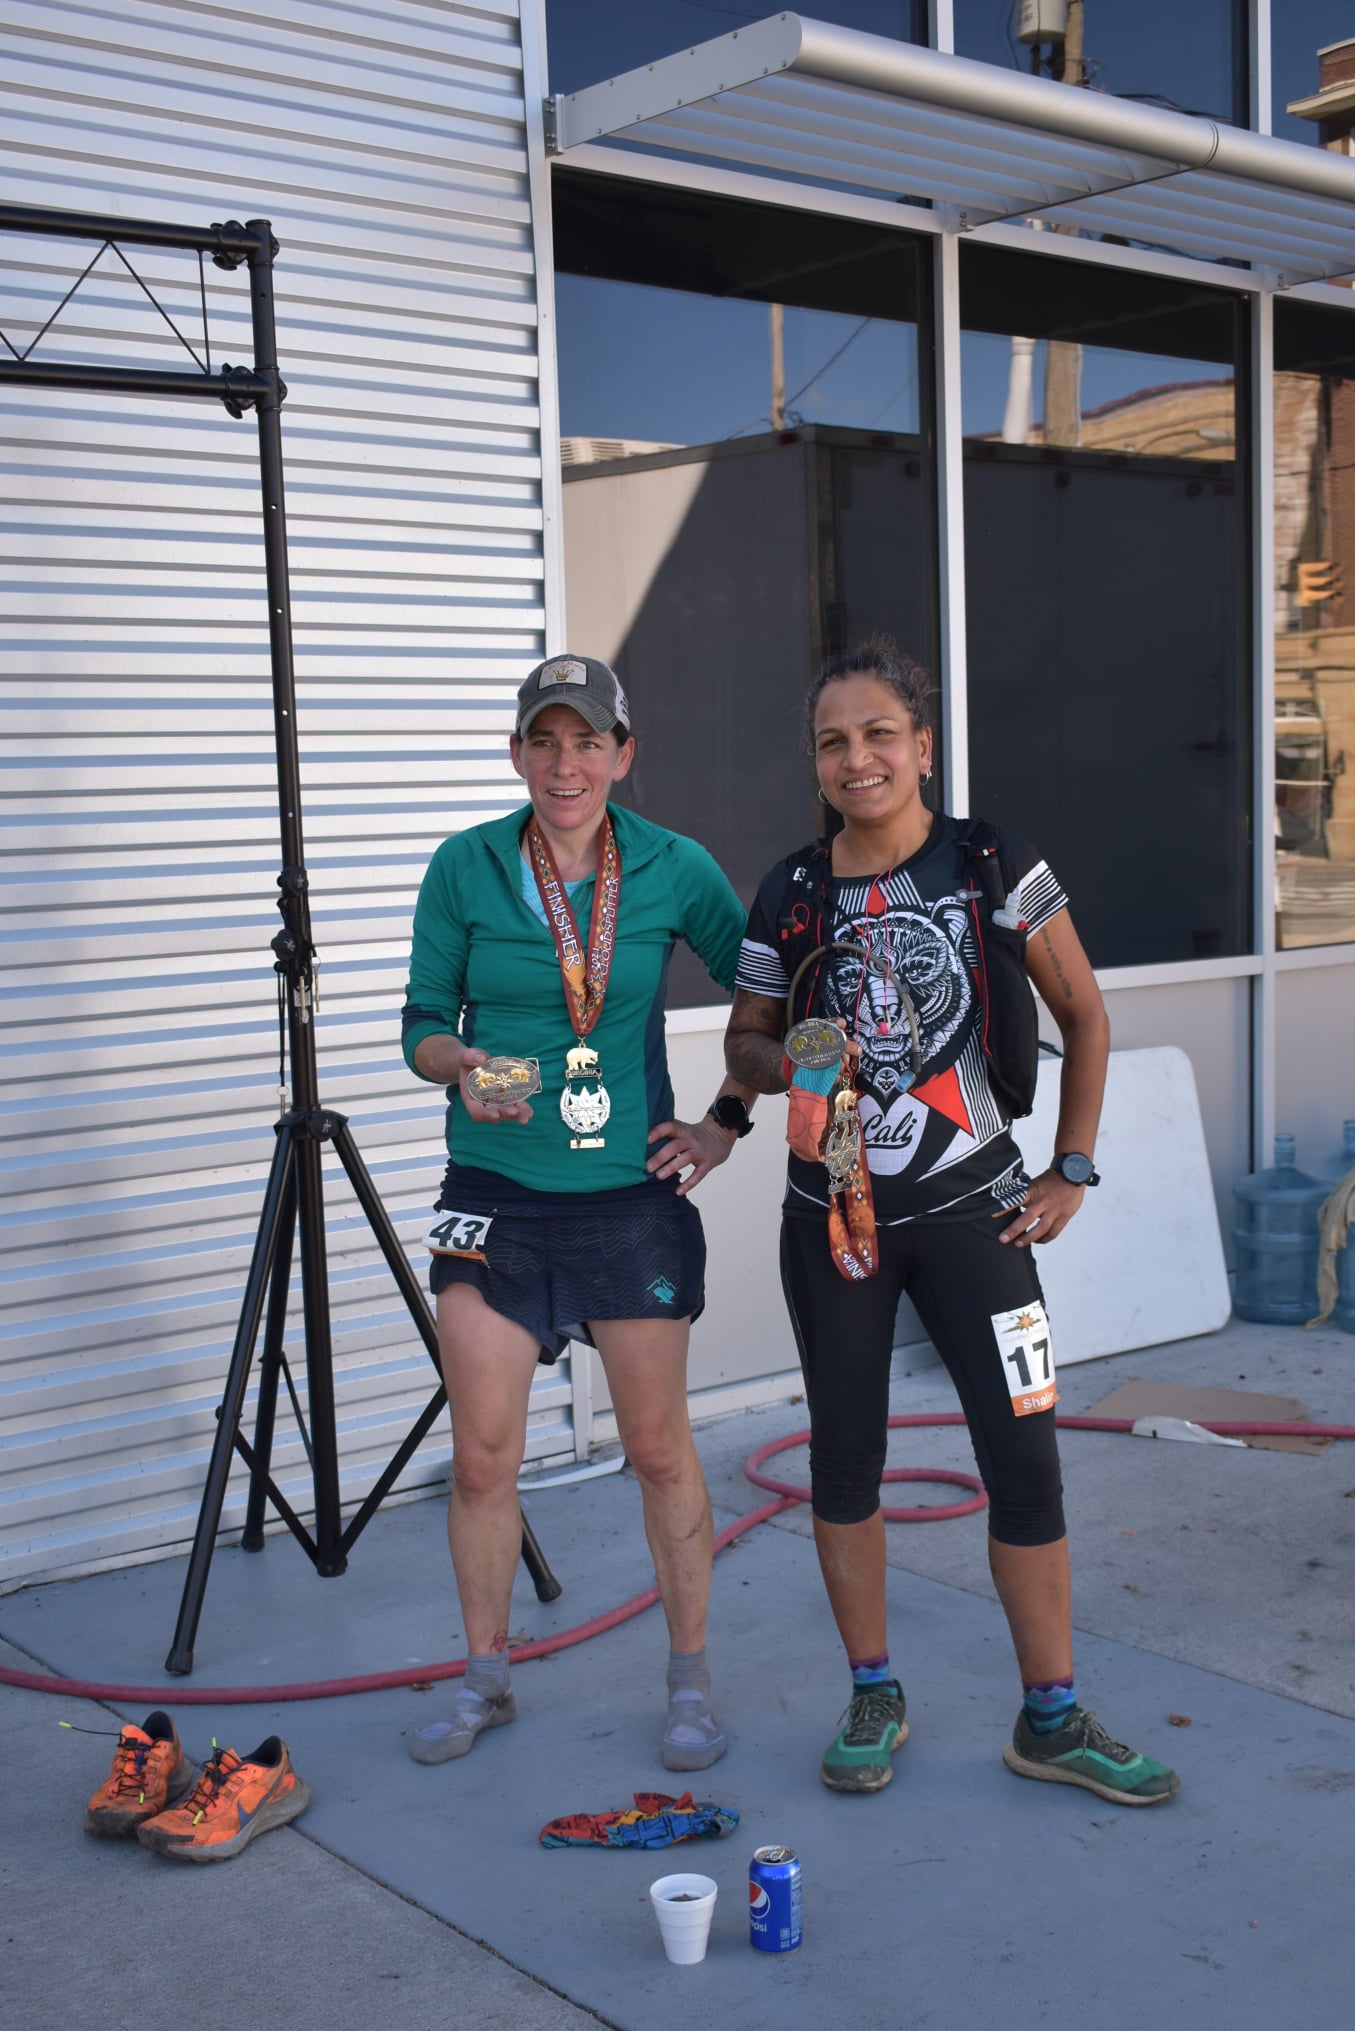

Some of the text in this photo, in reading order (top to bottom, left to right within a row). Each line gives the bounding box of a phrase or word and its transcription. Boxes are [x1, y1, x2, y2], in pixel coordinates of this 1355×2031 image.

[544, 881, 581, 970] FINISHER
[600, 876, 619, 976] CLOUDSPLITTER
[591, 947, 601, 970] 2021
[863, 1110, 918, 1149] Cali
[429, 1216, 486, 1251] 43
[1007, 1337, 1050, 1387] 17
